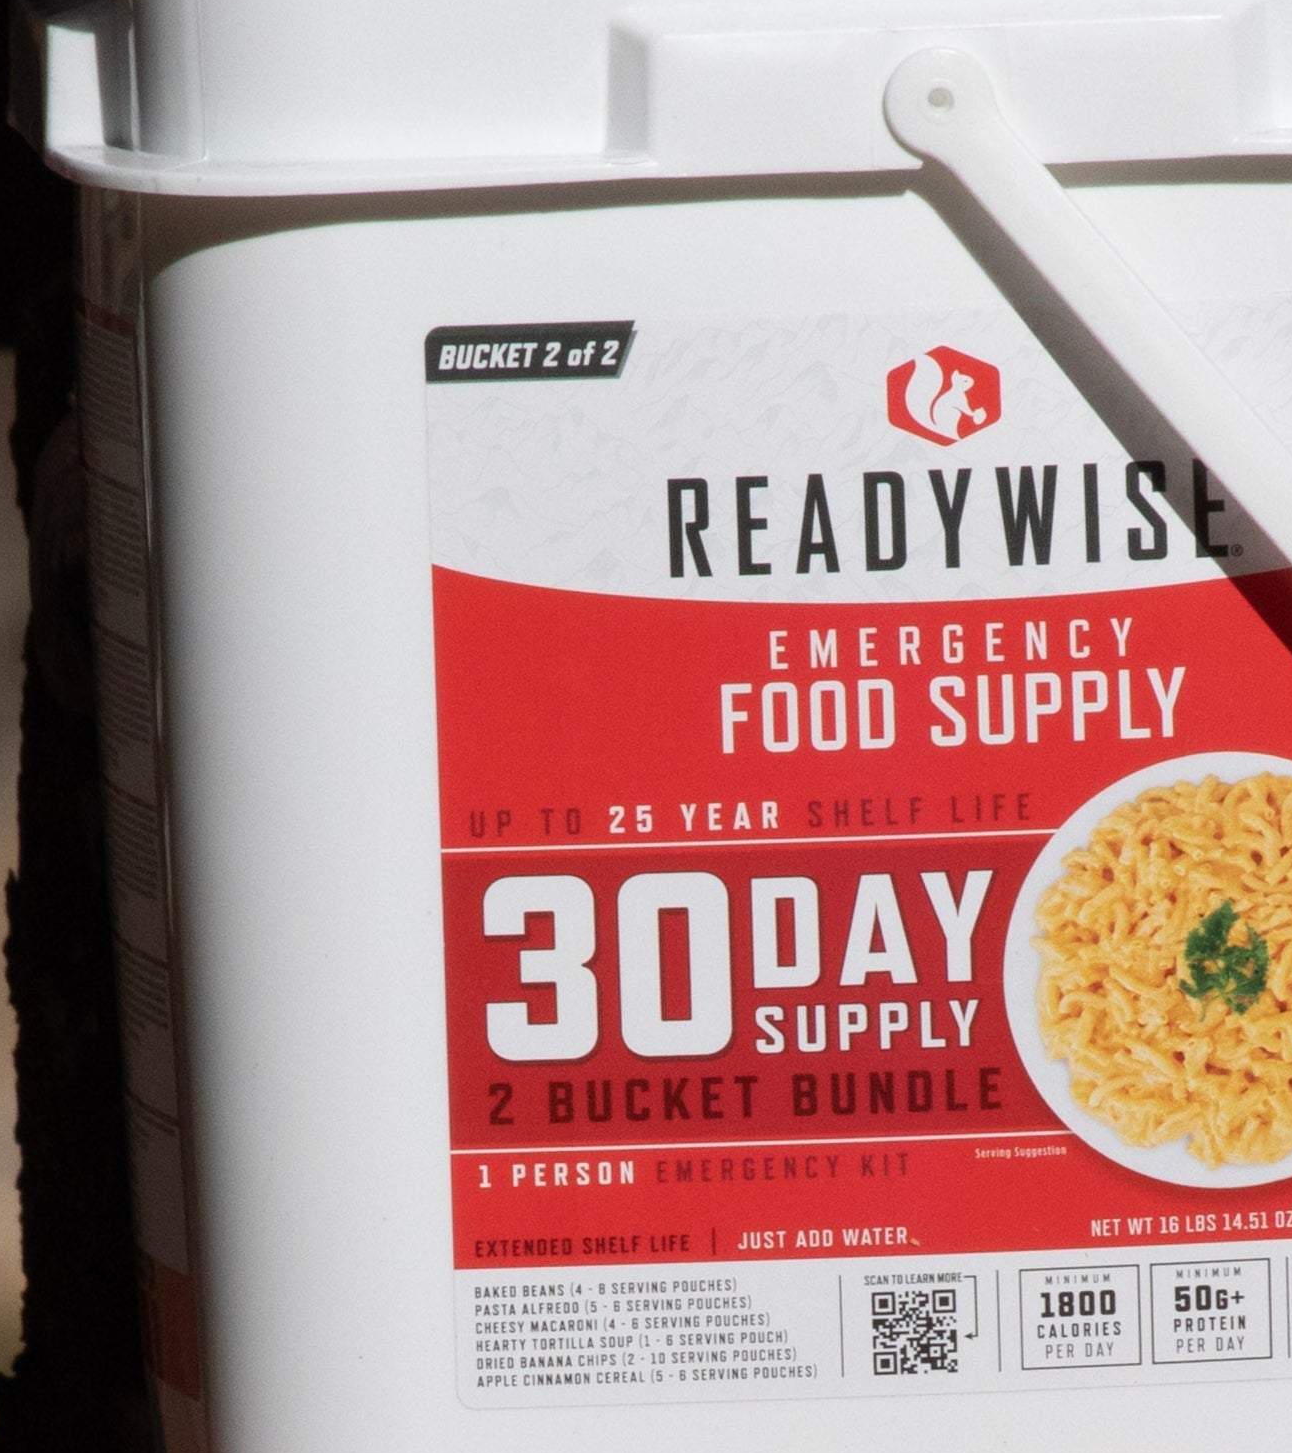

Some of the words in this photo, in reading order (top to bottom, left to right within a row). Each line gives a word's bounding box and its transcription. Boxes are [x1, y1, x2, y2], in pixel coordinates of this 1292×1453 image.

[439, 342, 538, 370] BUCKET
[543, 342, 561, 367] 2
[567, 341, 596, 366] of
[601, 340, 619, 365] 2
[770, 618, 1132, 670] EMERGENCY
[721, 679, 895, 754] FOOD
[929, 667, 1185, 747] SUPPLY
[469, 809, 511, 839] UP
[541, 807, 581, 836] TO
[609, 805, 652, 833] 25
[680, 801, 778, 831] YEAR
[808, 797, 922, 828] SHELF
[951, 793, 1029, 823] LIFE
[483, 872, 732, 1061] 30
[751, 870, 992, 988] DAY
[755, 1000, 978, 1053] SUPPLY
[489, 1082, 514, 1125] 2
[548, 1075, 758, 1123] BUCKET
[792, 1067, 1001, 1116] BUNDLE
[479, 1165, 491, 1188] 1
[512, 1161, 634, 1187] PERSON
[656, 1155, 838, 1183] EMERGENCY
[860, 1152, 908, 1176] KIT
[1091, 1219, 1121, 1236] NET
[1127, 1217, 1152, 1235] WT
[1160, 1216, 1179, 1234] 16
[1186, 1214, 1216, 1232] LBS
[1223, 1212, 1268, 1231] 14.51
[475, 1238, 573, 1258] EXTENDED
[582, 1235, 640, 1255] SHELF
[650, 1234, 689, 1253] LIFE
[738, 1231, 786, 1249] JUST
[796, 1229, 833, 1247] ADD
[842, 1227, 907, 1246] WATER
[864, 1275, 889, 1286] SCAN
[891, 1274, 903, 1285] TO
[905, 1273, 935, 1284] LEARN
[937, 1272, 962, 1283] MORE
[1045, 1274, 1110, 1284] MINIMUM
[1176, 1267, 1241, 1278] MINIMUM
[475, 1286, 516, 1299] BAKED
[523, 1284, 564, 1297] BEANS
[612, 1281, 666, 1294] SERVING
[673, 1278, 736, 1292] POUCHES)
[1175, 1285, 1244, 1312] 50G+
[475, 1304, 516, 1316] PASTA
[522, 1302, 579, 1315] ALFREDO
[626, 1299, 682, 1312] SERVING
[688, 1295, 751, 1310] POUCHES)
[1041, 1290, 1116, 1318] 1800
[476, 1321, 524, 1334] CHEESY
[530, 1319, 597, 1332] MACARONI
[645, 1316, 700, 1329] SERVING
[706, 1313, 770, 1327] POUCHES)
[1037, 1321, 1121, 1339] CALORIES
[1174, 1316, 1246, 1332] PROTEIN
[476, 1339, 526, 1352] HEARTY
[532, 1337, 594, 1350] TORTILLA
[600, 1335, 633, 1348] SOUP
[679, 1332, 734, 1346] SERVING
[740, 1330, 787, 1344] POUCH)
[1045, 1343, 1074, 1359] PER
[1085, 1342, 1113, 1357] DAY
[1176, 1338, 1205, 1353] PER
[1216, 1336, 1244, 1351] DAY
[477, 1357, 514, 1370] DRIED
[520, 1356, 572, 1368] BANANA
[578, 1354, 616, 1367] CHIPS
[672, 1350, 727, 1364] SERVING
[733, 1347, 796, 1362] POUCHES)
[477, 1375, 517, 1387] APPLE
[524, 1373, 590, 1386] CINNAMON
[597, 1371, 644, 1384] CEREAL
[692, 1368, 747, 1381] SERVING
[753, 1364, 817, 1379] POUCHES)
